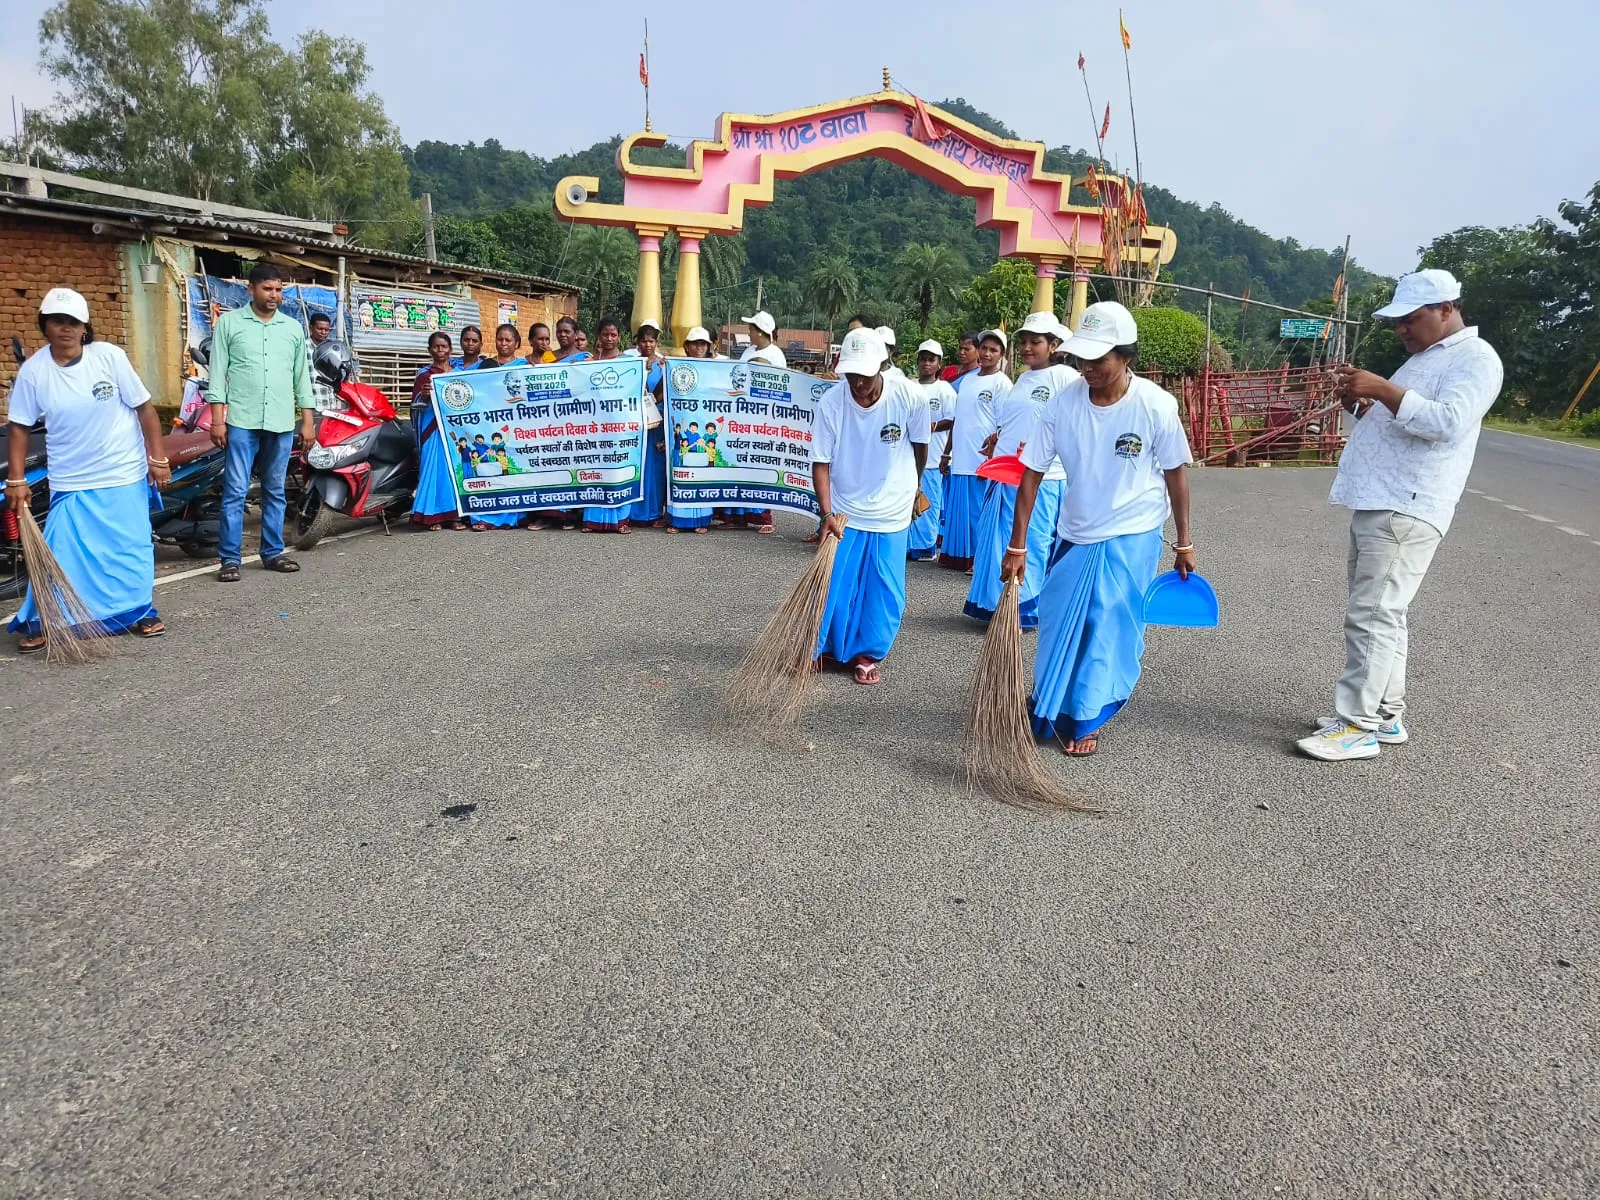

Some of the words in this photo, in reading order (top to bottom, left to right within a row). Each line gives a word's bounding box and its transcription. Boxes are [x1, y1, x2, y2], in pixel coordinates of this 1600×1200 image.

[733, 126, 751, 149] श्री
[755, 130, 773, 149] श्री
[820, 111, 867, 138] बाबा
[781, 374, 790, 383] ही
[446, 412, 480, 426] स्वच्छ
[484, 408, 513, 424] भारत
[519, 405, 549, 419] मिशन
[553, 400, 596, 419] (ग्रामीण)
[671, 398, 698, 411] स्वच्छ
[703, 400, 731, 413] भारत
[736, 398, 768, 415] मिशन
[771, 403, 814, 426] (ग्रामीण)
[513, 427, 537, 440] विश्व
[538, 424, 563, 438] पर्यटन
[565, 424, 587, 436] दिवस
[589, 421, 598, 434] के
[600, 422, 626, 433] अवसर
[627, 423, 639, 432] पर
[728, 421, 750, 434] विश्व
[753, 423, 779, 436] पर्यटन
[781, 426, 803, 440] दिवस
[804, 430, 812, 442] के
[515, 444, 539, 455] पर्यटन
[541, 441, 562, 453] स्थलों
[563, 440, 573, 452] की
[575, 440, 597, 452] विशेष
[726, 438, 750, 450] पर्यटन
[752, 439, 773, 451] स्थलों
[775, 442, 786, 453] की
[529, 454, 540, 467] एवं
[541, 454, 571, 467] स्वच्छता
[573, 453, 601, 465] श्रमदान
[603, 450, 629, 463] कार्यक्रम
[736, 452, 748, 463] एवं
[750, 455, 781, 466] स्वच्छता
[784, 459, 810, 471] श्रमदान
[468, 496, 496, 510] जिला
[498, 496, 519, 507] जल
[521, 491, 537, 504] एवं
[540, 492, 577, 504] स्वच्छता
[579, 488, 604, 502] समिति
[607, 488, 632, 503] दुमका
[699, 489, 720, 499] जल
[722, 487, 738, 499] एवं
[740, 489, 779, 501] स्वच्छता
[782, 492, 810, 506] समिति
